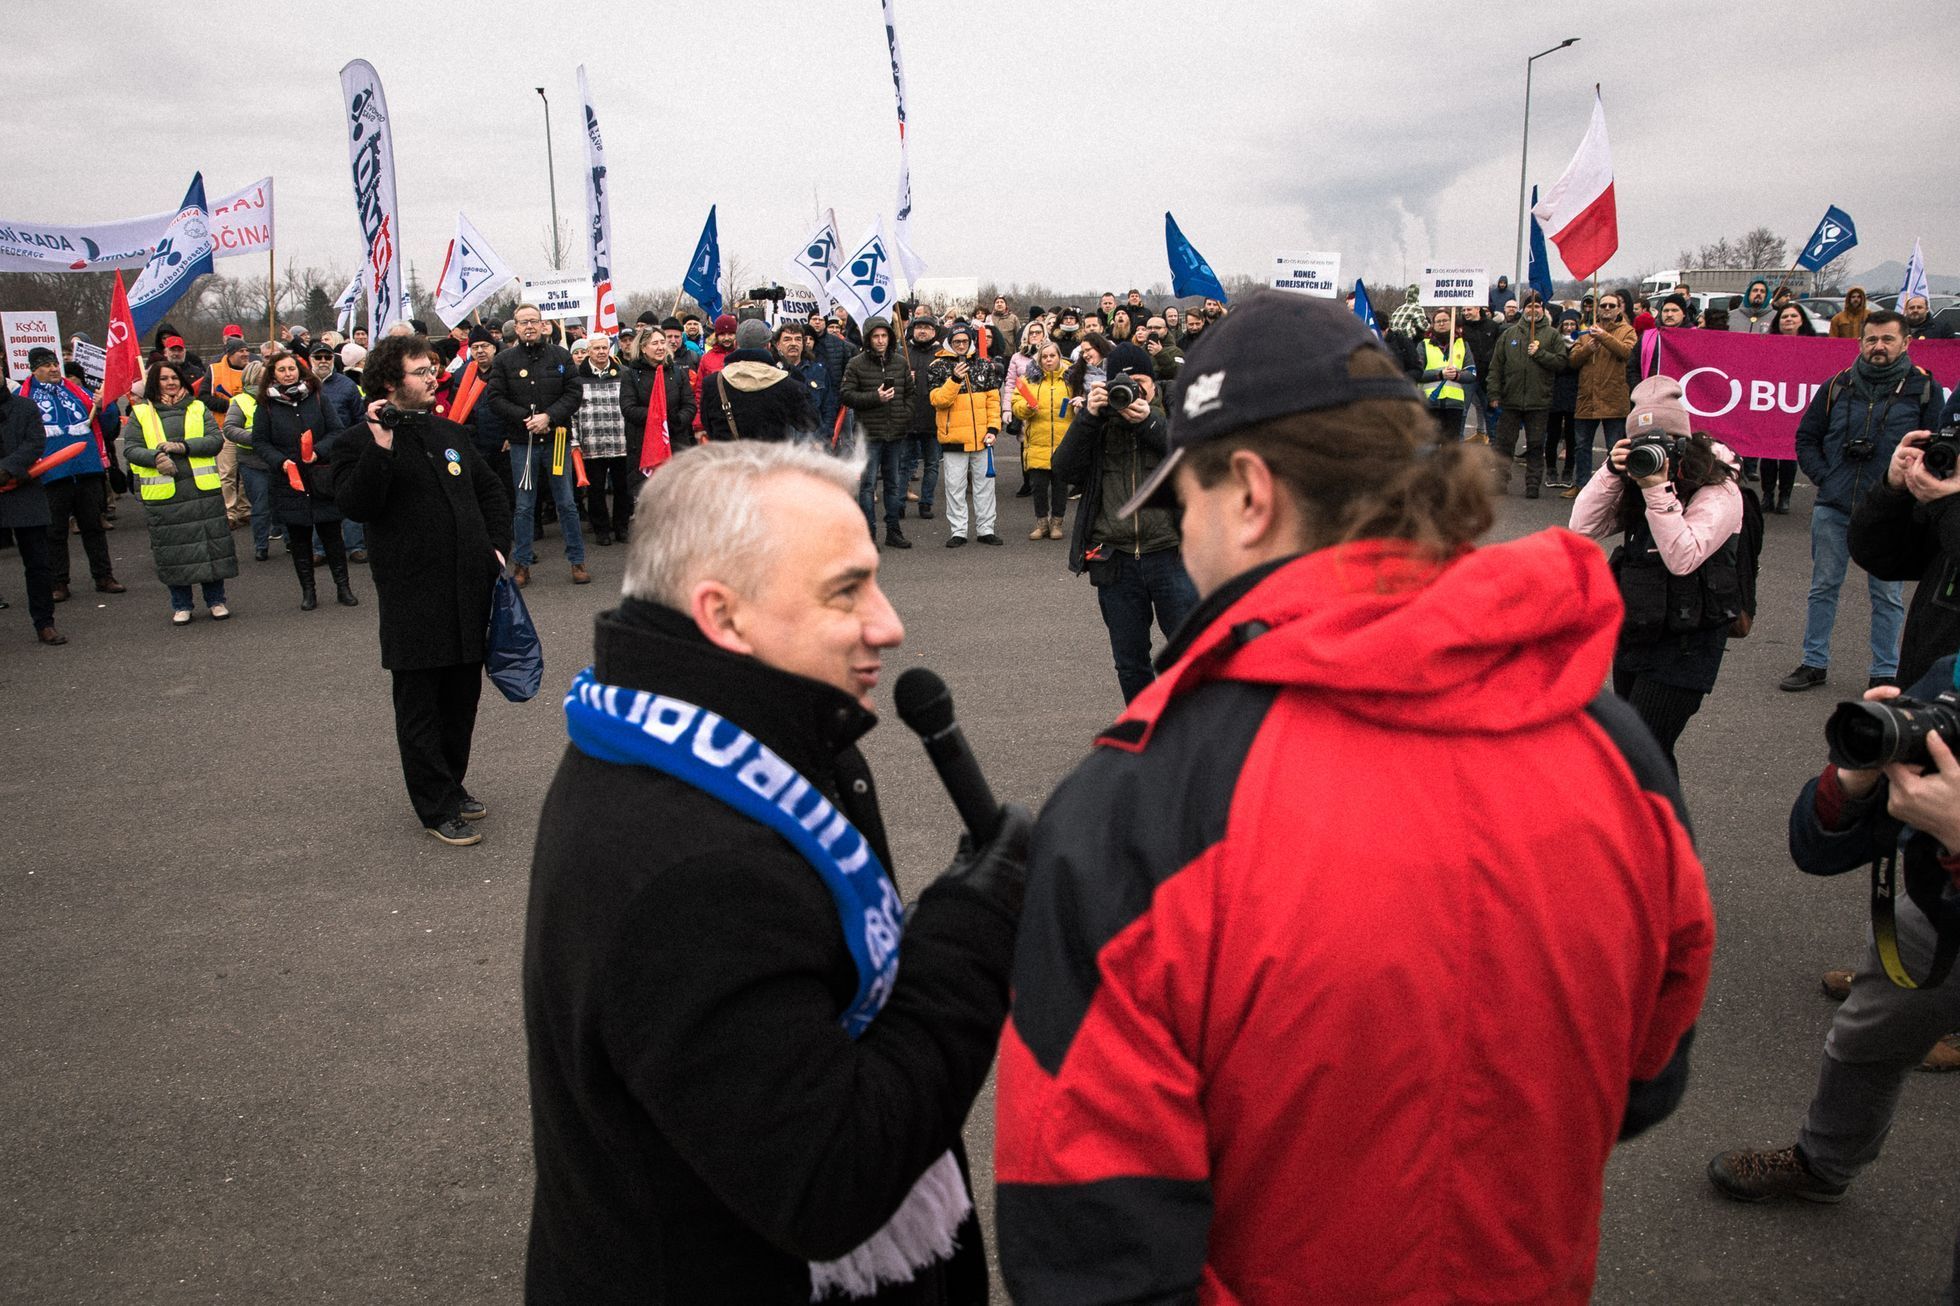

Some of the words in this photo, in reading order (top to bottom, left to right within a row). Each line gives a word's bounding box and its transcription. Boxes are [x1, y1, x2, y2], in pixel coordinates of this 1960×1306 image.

[18, 231, 75, 252] RADA
[211, 224, 270, 251] OČINA
[1293, 270, 1316, 278] KONEC
[1276, 280, 1319, 289] KOREJSKÝCH
[1320, 281, 1332, 290] LŽÍ!
[548, 291, 560, 300] 3%
[561, 290, 568, 299] JE
[539, 303, 556, 311] MOC
[557, 300, 580, 310] MÁLO!
[782, 300, 819, 314] NEJSME
[16, 321, 47, 333] KSČM
[10, 335, 55, 344] podporuje
[13, 361, 30, 370] Nex
